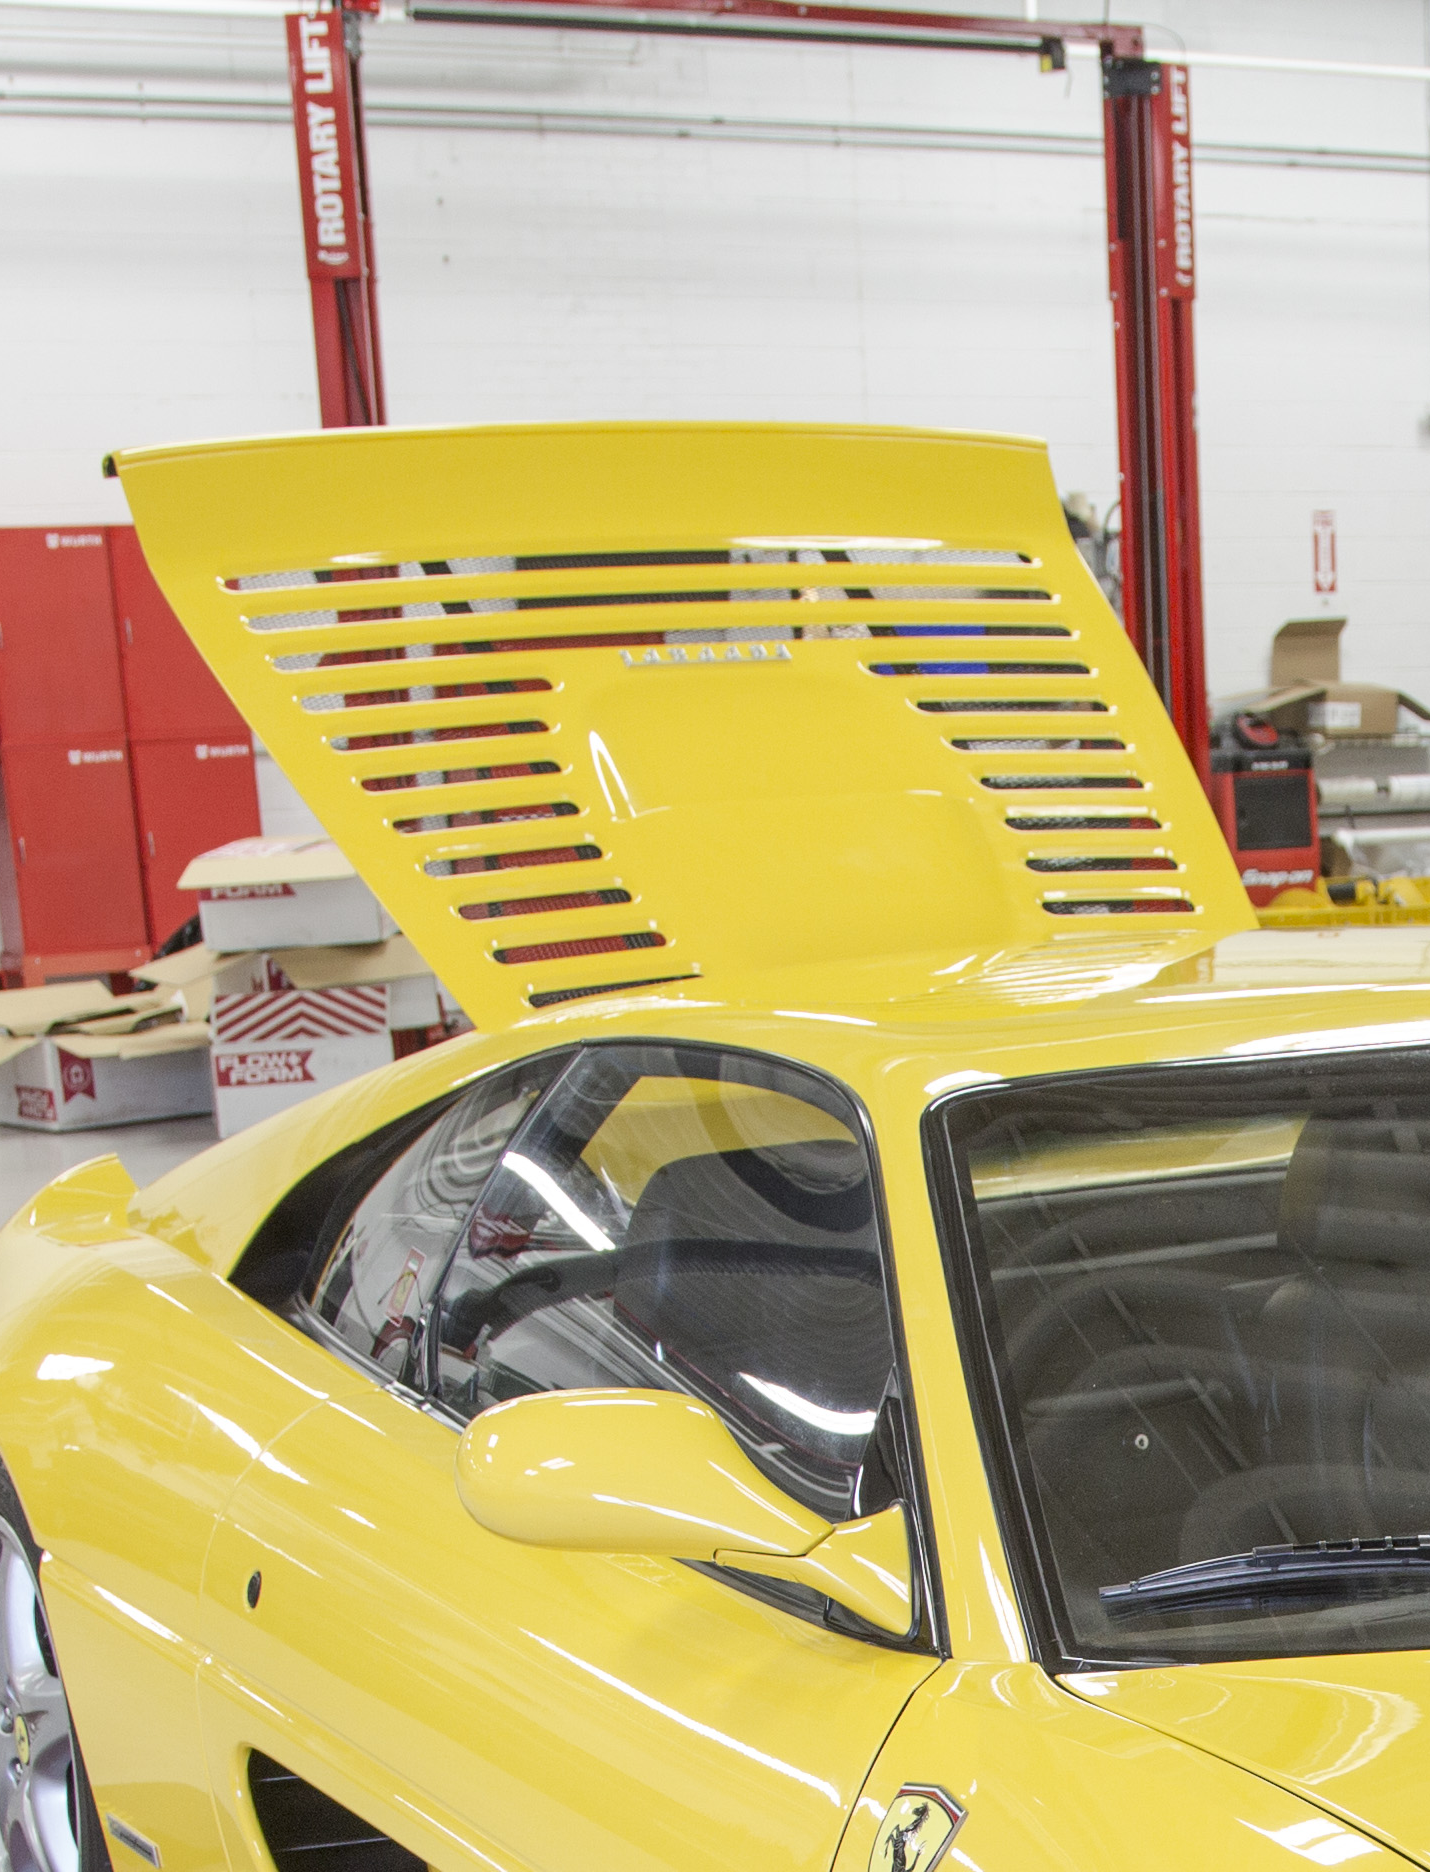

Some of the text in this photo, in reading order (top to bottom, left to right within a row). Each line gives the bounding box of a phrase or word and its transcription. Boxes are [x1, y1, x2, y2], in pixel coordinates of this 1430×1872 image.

[299, 15, 346, 247] ROTARY LIFT
[1171, 65, 1192, 271] ROTARY LIFT
[1242, 868, 1314, 888] Snap-on
[230, 1064, 304, 1085] FORM
